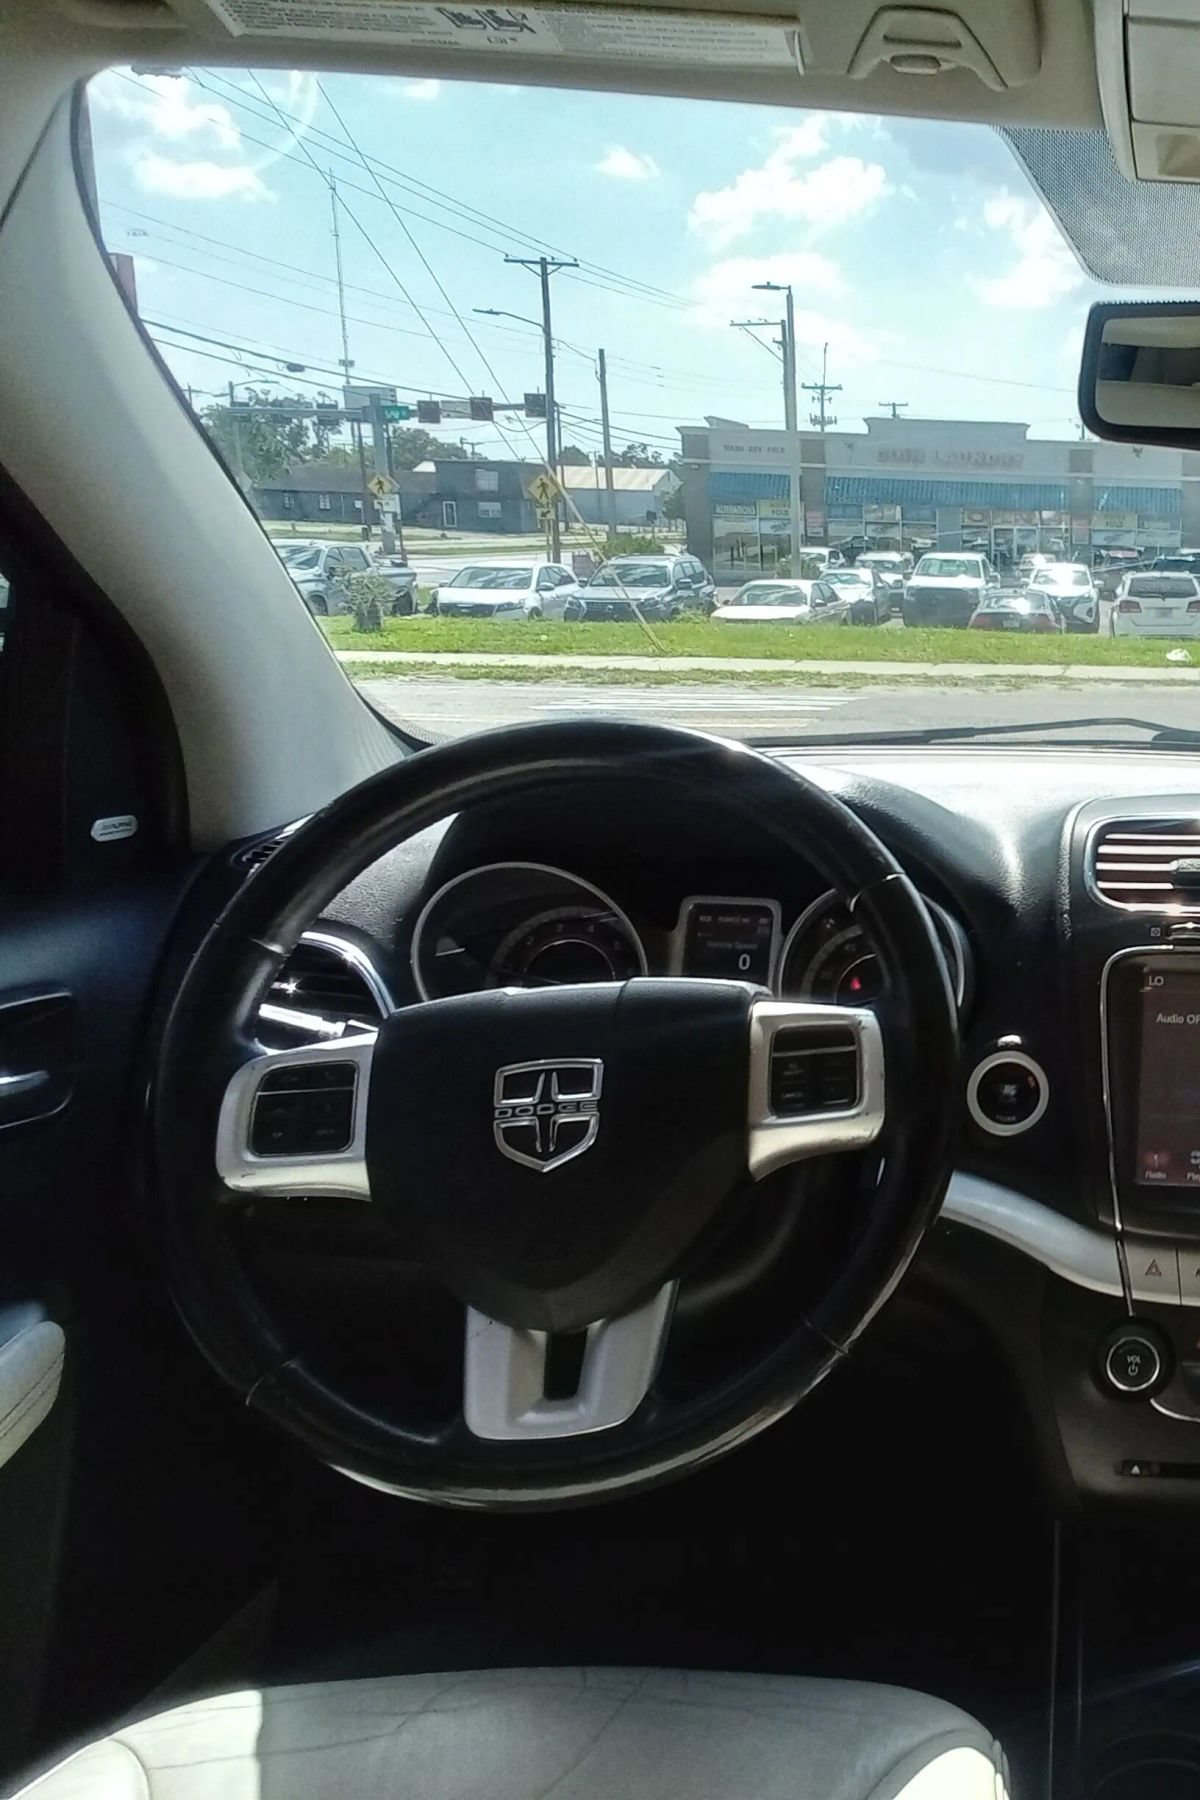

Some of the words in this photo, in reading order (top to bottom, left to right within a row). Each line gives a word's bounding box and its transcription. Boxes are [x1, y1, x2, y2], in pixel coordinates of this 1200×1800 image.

[738, 954, 750, 970] 0
[1148, 975, 1165, 987] LO
[1156, 1013, 1184, 1025] Audio
[494, 1101, 598, 1118] DODGE
[1145, 1170, 1167, 1181] Radio
[1126, 1354, 1141, 1364] VOL
